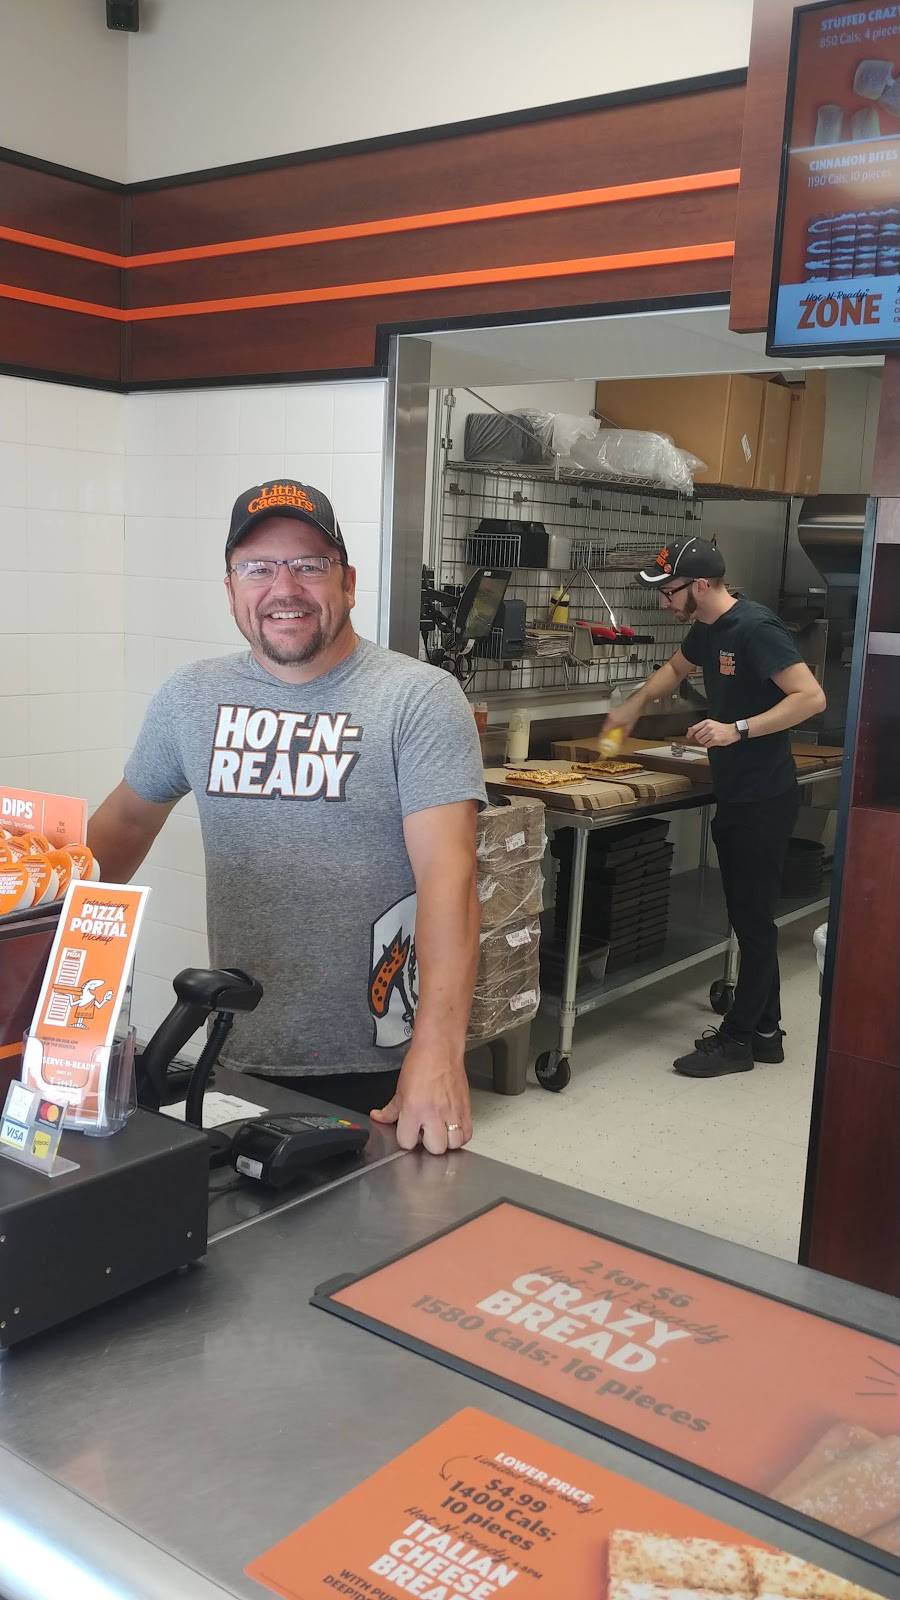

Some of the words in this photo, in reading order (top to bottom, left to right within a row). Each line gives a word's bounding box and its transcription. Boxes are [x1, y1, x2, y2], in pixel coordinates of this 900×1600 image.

[821, 12, 866, 31] STUFFED
[864, 27, 871, 39] 4
[809, 152, 866, 171] CINNAMON
[868, 150, 898, 164] BITES
[797, 293, 882, 330] ZONE
[247, 495, 315, 513] Caesars
[261, 485, 307, 500] Little
[213, 704, 362, 751] HOT-N-
[207, 748, 358, 800] READY
[2, 797, 33, 820] DIPS
[81, 903, 124, 922] PIZZA
[82, 898, 130, 912] Introducing
[69, 917, 128, 938] PORTAL
[81, 932, 114, 945] Pickup
[6, 1126, 24, 1141] VISA
[579, 1260, 603, 1275] 2
[602, 1269, 650, 1292] for
[651, 1286, 694, 1308] $6
[511, 1273, 692, 1349] CRAZY
[475, 1289, 657, 1373] BREAD
[410, 1294, 485, 1331] 1580
[484, 1326, 560, 1368] Cals;
[560, 1356, 603, 1382] 16
[594, 1378, 711, 1434] pieces
[494, 1452, 549, 1482] LOWER
[547, 1476, 595, 1504] PRICE
[449, 1480, 505, 1513] 1400
[504, 1508, 557, 1542] Cals;
[485, 1479, 548, 1513] $4.99
[440, 1495, 468, 1515] 10
[462, 1512, 535, 1551] pieces
[388, 1537, 498, 1600] CHEESE
[402, 1518, 519, 1588] ITALIAN
[340, 1569, 372, 1592] WITH
[368, 1554, 460, 1600] BREA
